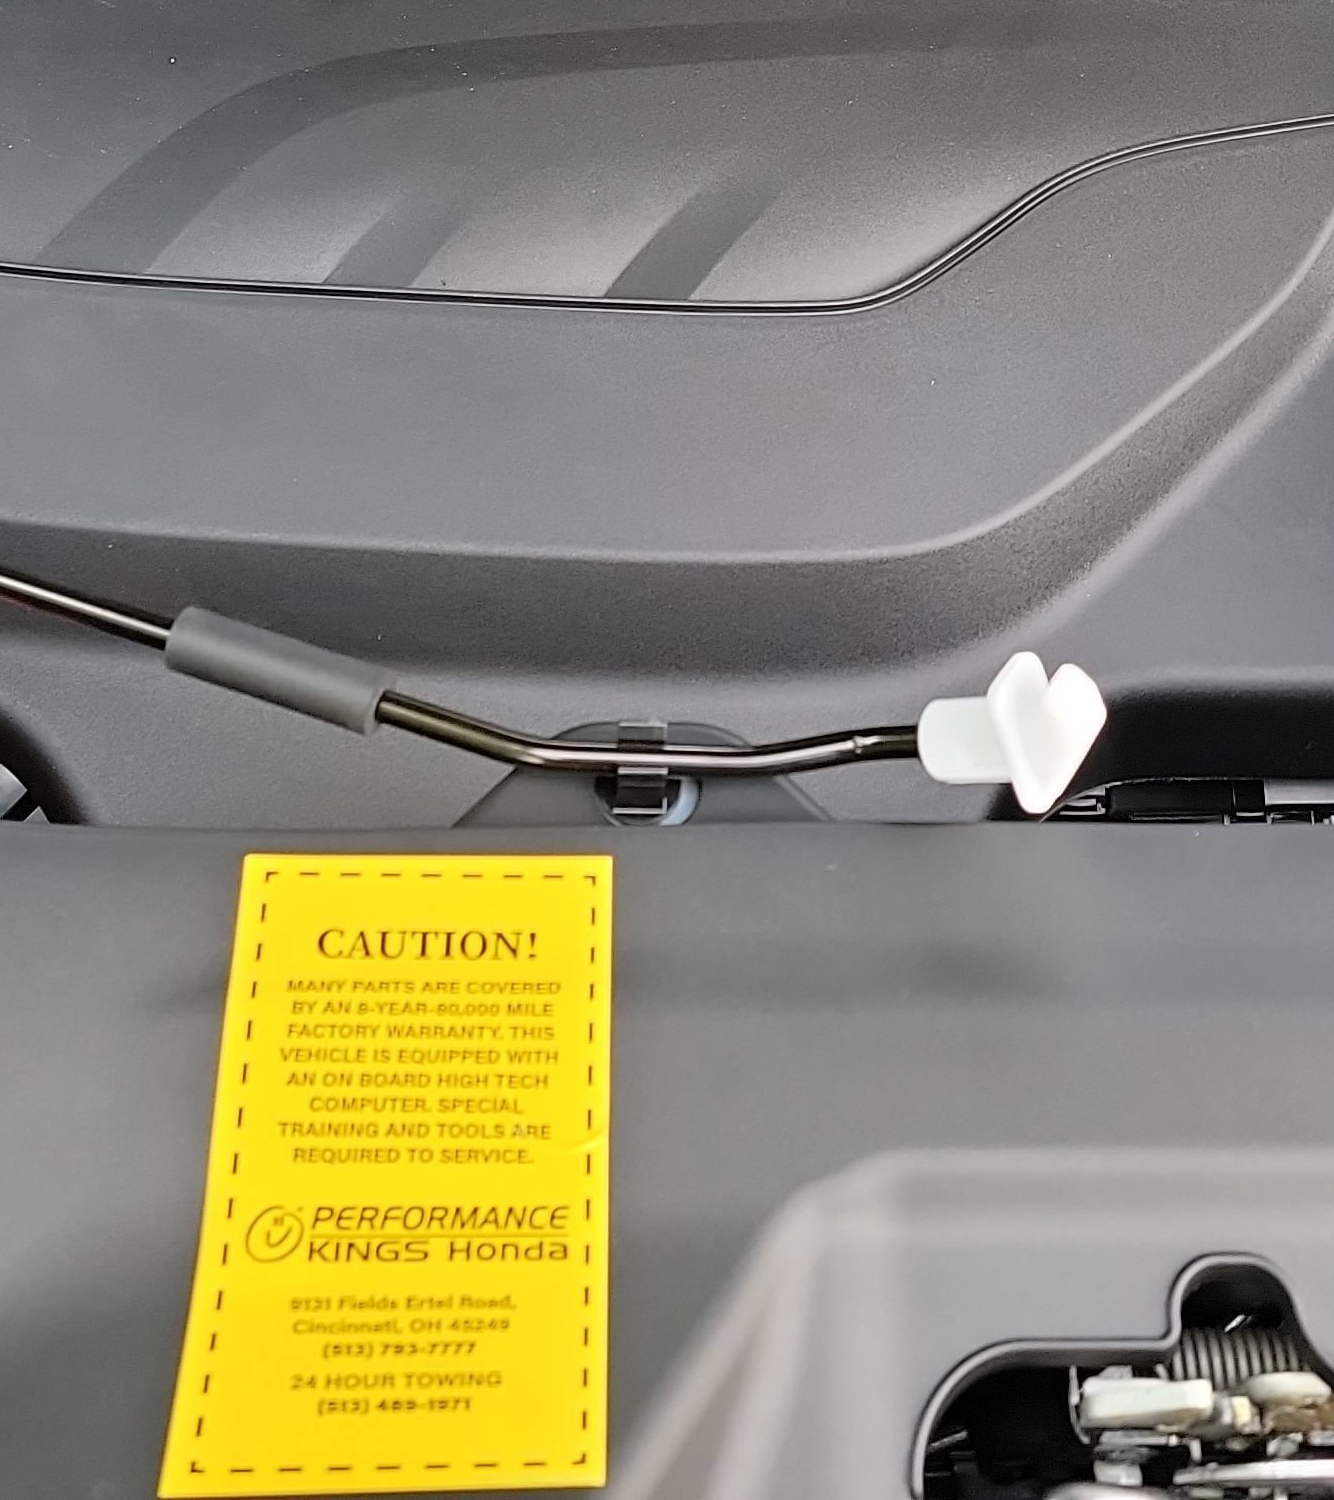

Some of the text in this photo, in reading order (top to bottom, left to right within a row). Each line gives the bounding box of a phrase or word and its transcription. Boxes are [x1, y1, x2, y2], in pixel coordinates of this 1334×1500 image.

[317, 928, 537, 961] CAUTION!
[286, 979, 561, 996] MANY PARTS ARE COVERED
[291, 1002, 318, 1015] BY
[322, 1002, 351, 1016] AN
[506, 1003, 555, 1017] MILE
[286, 1024, 380, 1039] FACTORY
[510, 1026, 555, 1041] THIS
[279, 1048, 559, 1066] VEHICLE IS EQUIPPED WITH
[286, 1072, 549, 1089] AN ON BOARD HIGH TECH
[437, 1097, 524, 1114] SPECIAL
[278, 1122, 552, 1140] TRAINING AND TOOLS ARE
[292, 1148, 534, 1164] REQUIRED TO SERVICE.
[311, 1205, 570, 1231] PERFORMANCE
[307, 1240, 569, 1263] KINGS Honda
[409, 1319, 442, 1334] OH
[324, 1373, 396, 1390] HOUR
[405, 1371, 503, 1388] TOWING
